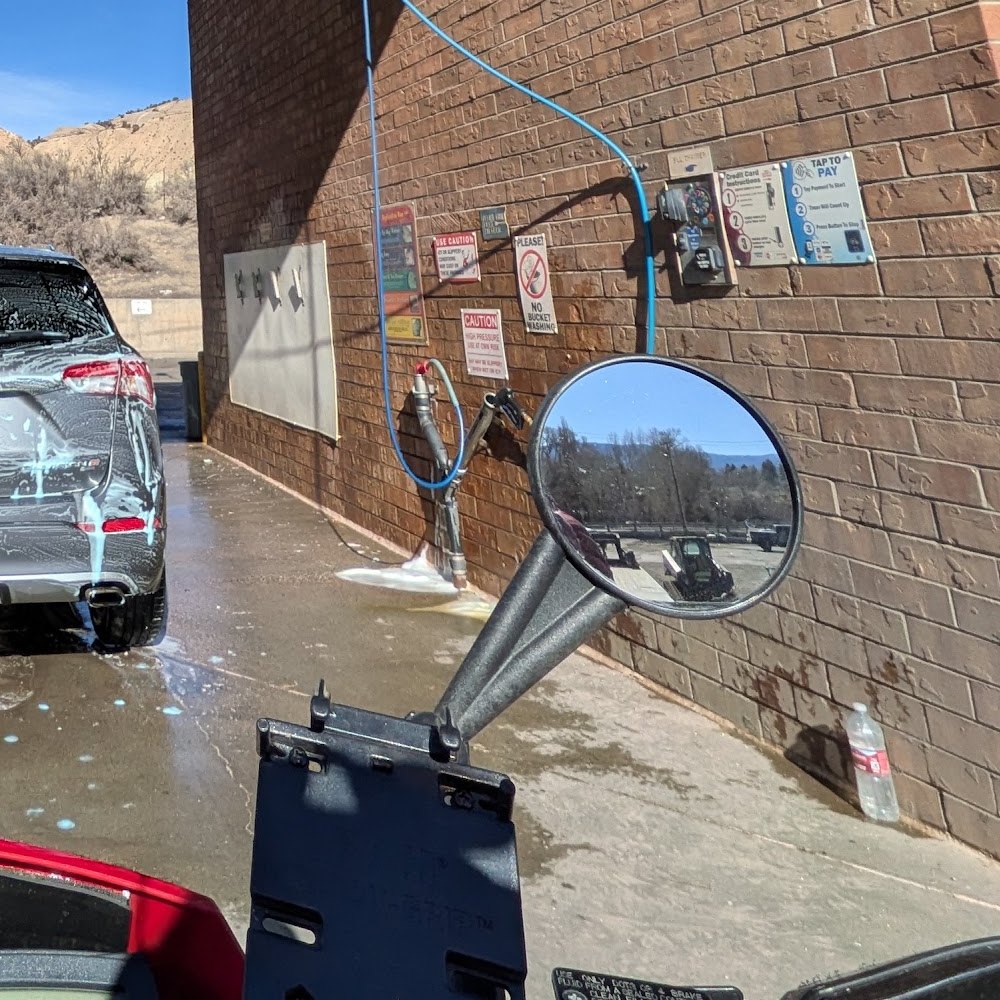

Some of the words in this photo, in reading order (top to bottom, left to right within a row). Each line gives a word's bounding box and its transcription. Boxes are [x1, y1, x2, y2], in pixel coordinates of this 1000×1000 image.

[811, 158, 828, 168] TAP
[829, 156, 841, 164] TO
[726, 172, 744, 180] Credit
[818, 166, 838, 178] PAY
[726, 178, 760, 187] Instructions
[733, 216, 738, 226] 2
[437, 238, 446, 246] USE
[449, 236, 474, 245] CAUTION
[517, 236, 544, 248] PLEASE!
[531, 302, 543, 312] NO
[465, 315, 497, 328] CAUTION
[528, 313, 551, 322] BUCKET
[526, 321, 556, 331] WASHING
[477, 333, 499, 341] PRESSURE
[557, 978, 583, 988] FLUID
[585, 982, 610, 993] FROM
[622, 988, 658, 1000] SEALED
[582, 974, 606, 984] ONLY
[670, 989, 702, 1000] BRAKE
[590, 990, 622, 1000] CLEAN
